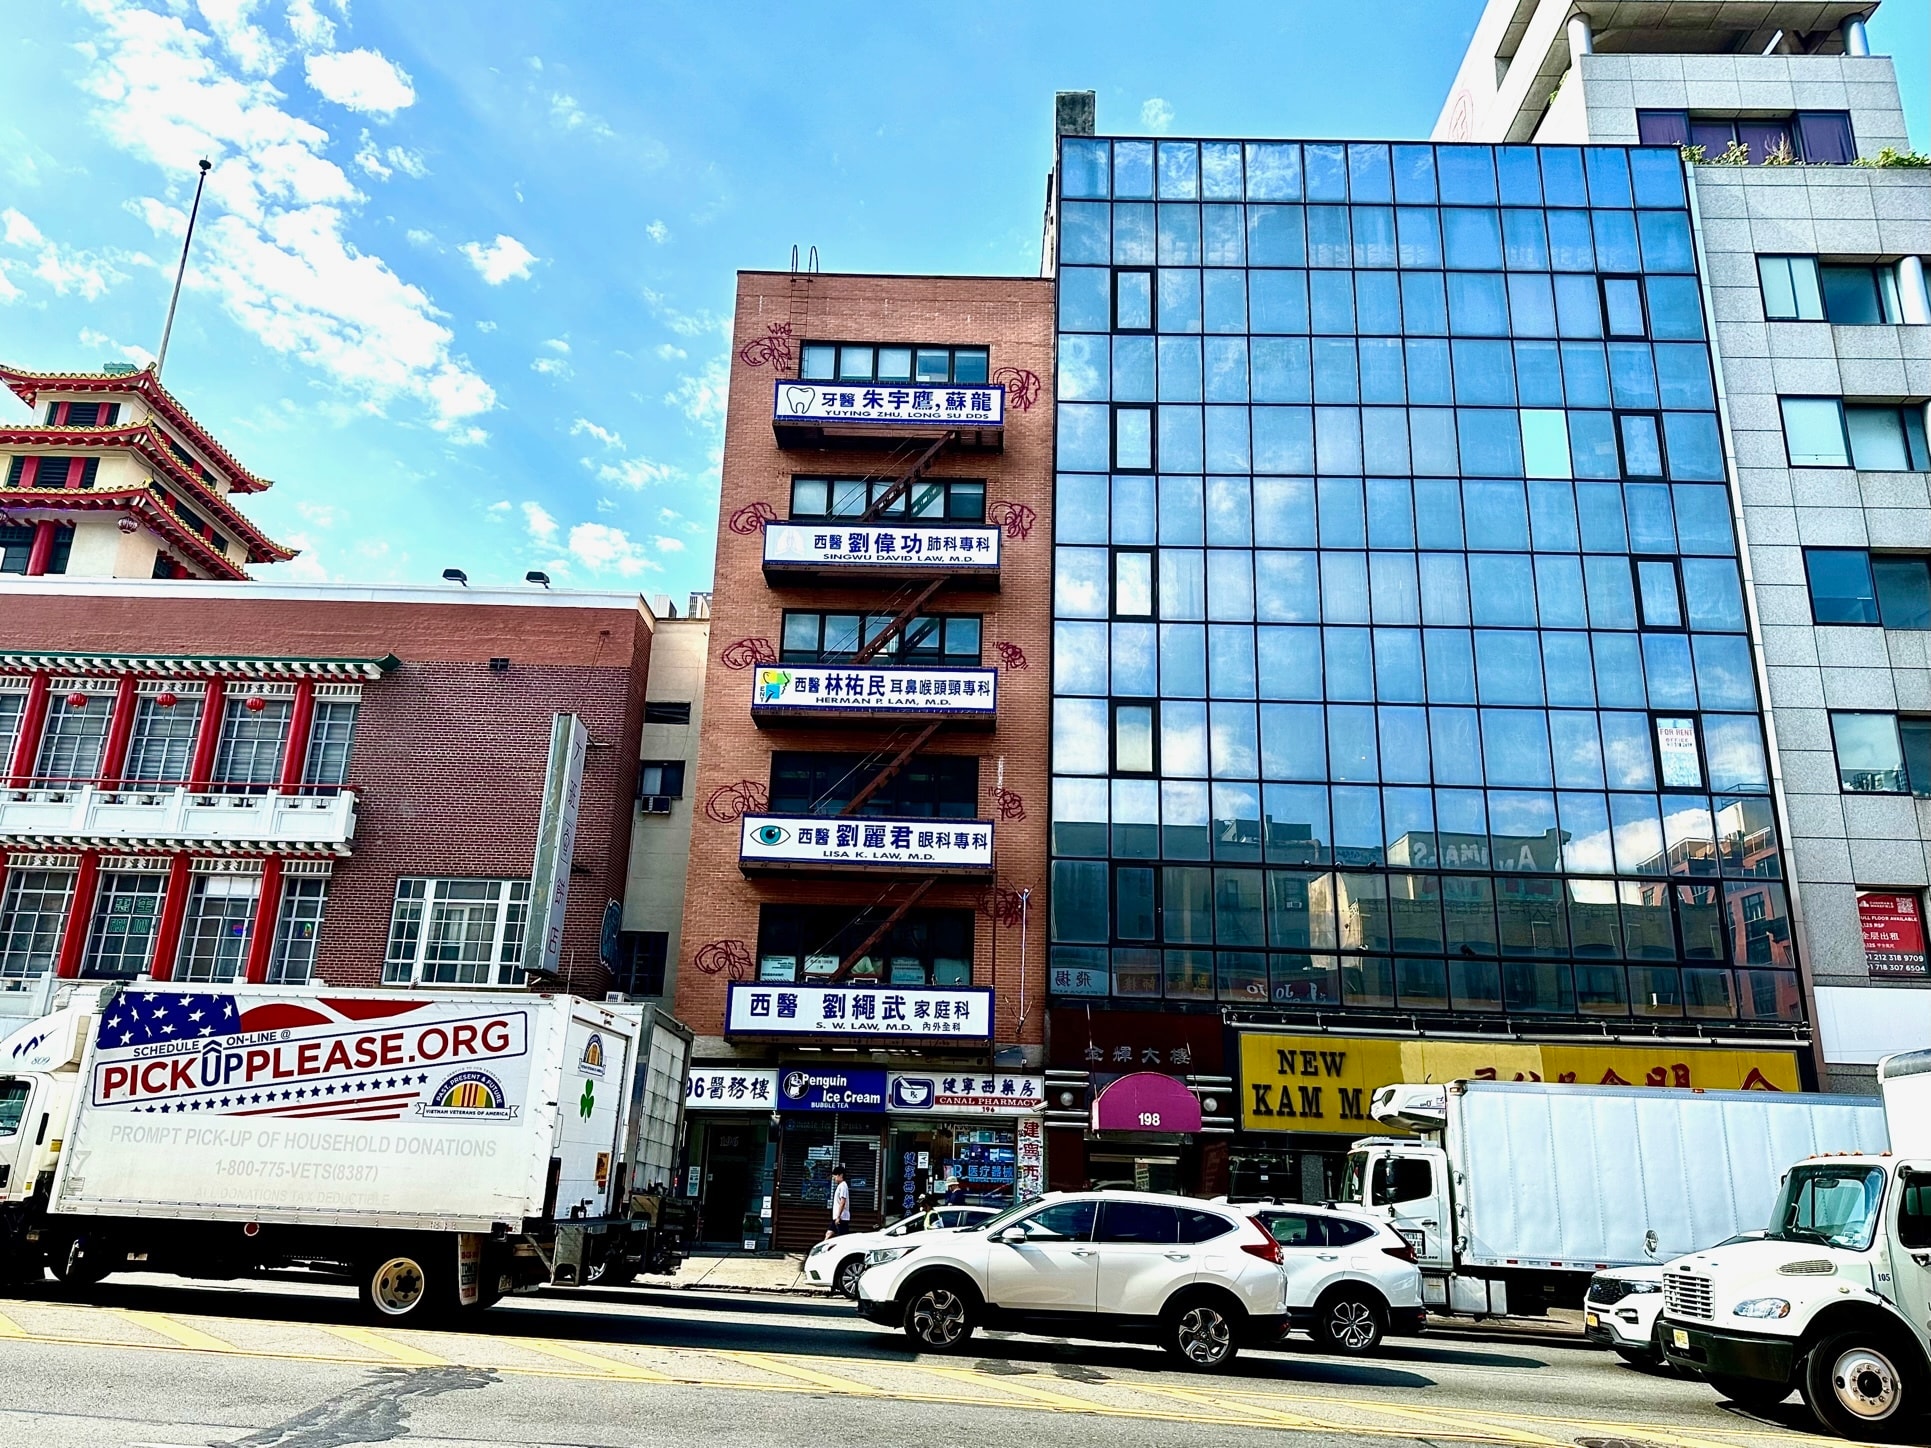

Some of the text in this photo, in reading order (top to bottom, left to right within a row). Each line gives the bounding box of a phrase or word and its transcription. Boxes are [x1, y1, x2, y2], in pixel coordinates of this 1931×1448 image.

[821, 392, 856, 408] 牙醫
[825, 409, 871, 417] YUYING
[907, 411, 942, 419] LONG
[946, 412, 962, 420] SU
[965, 412, 990, 420] DDS
[813, 532, 991, 555] 西醫 劉偉功 肺科專科
[823, 553, 976, 563] SINGWU DAVID LAW, M.D.
[794, 676, 821, 694] 西醫
[824, 673, 886, 698] 林祐民
[815, 696, 871, 704] HERMAN
[887, 697, 920, 706] LAM,
[924, 698, 952, 706] M.D.
[797, 824, 988, 850] 西醫 劉麗君 眼科專科
[823, 850, 936, 861] LISA K. LAW, M.D.
[750, 993, 970, 1021] 西醫 劉繩武 家庭科
[815, 1021, 913, 1032] S. W. LAW, M.D.
[133, 1029, 291, 1058] SCHEDULE ON-LINE @
[31, 1057, 50, 1065] 809
[103, 1020, 510, 1099] PICKUPPLEASE.ORG
[1277, 1049, 1346, 1077] NEW
[449, 1073, 481, 1086] PRESENT
[485, 1078, 503, 1104] FUTURE
[802, 1073, 848, 1089] Penguin
[823, 1090, 881, 1104] Ice Cream
[939, 1096, 1038, 1107] CANAL PHARMACY
[1252, 1083, 1375, 1120] KAM M
[1138, 1112, 1161, 1126] 198
[110, 1125, 497, 1158] PROMPT PICK-UP OF HOUSEHOLD DONATIONS
[215, 1158, 378, 1182] 1-800-775-VETS(8387)
[220, 1187, 288, 1201] DONATIONS
[316, 1191, 390, 1206] DEDUCTIBLE
[1877, 1273, 1891, 1282] 105
